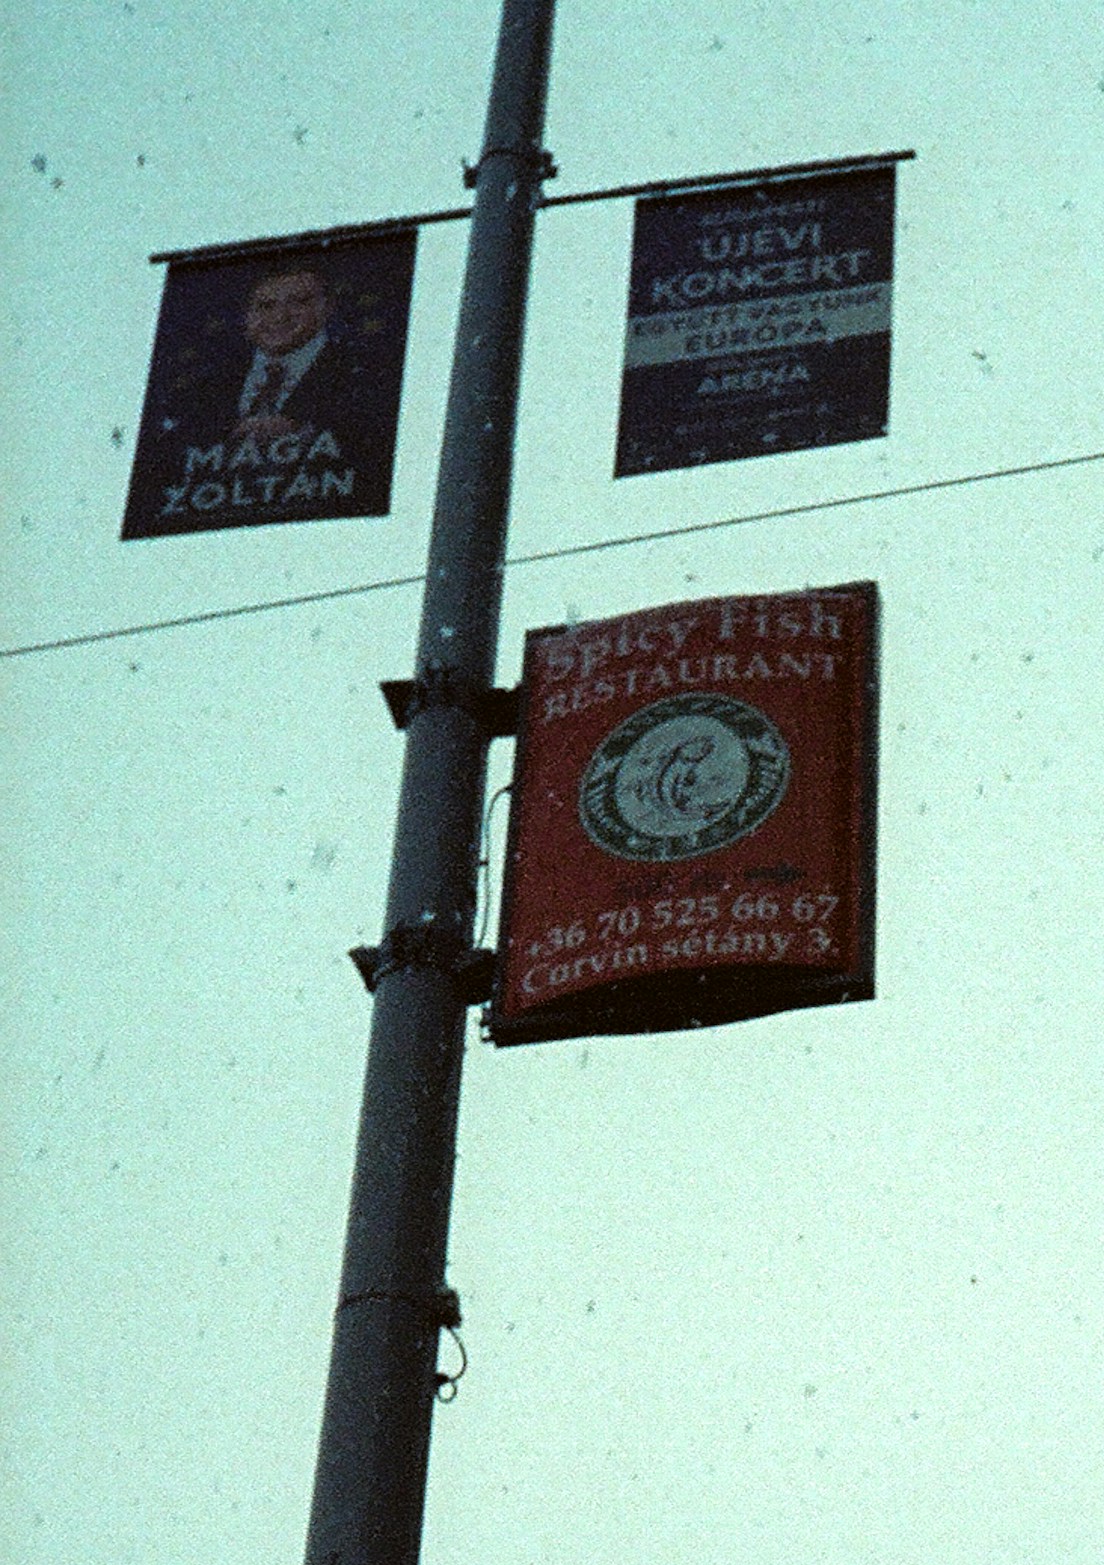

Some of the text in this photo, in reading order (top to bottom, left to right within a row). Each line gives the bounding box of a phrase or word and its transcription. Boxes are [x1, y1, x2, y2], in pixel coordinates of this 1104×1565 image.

[541, 598, 843, 682] Spicy Fish
[542, 652, 838, 724] RESTAURANT
[597, 905, 640, 941] 70
[652, 895, 719, 932] 525
[731, 893, 780, 922] 66
[791, 892, 839, 922] 67
[522, 938, 648, 994] Corvin
